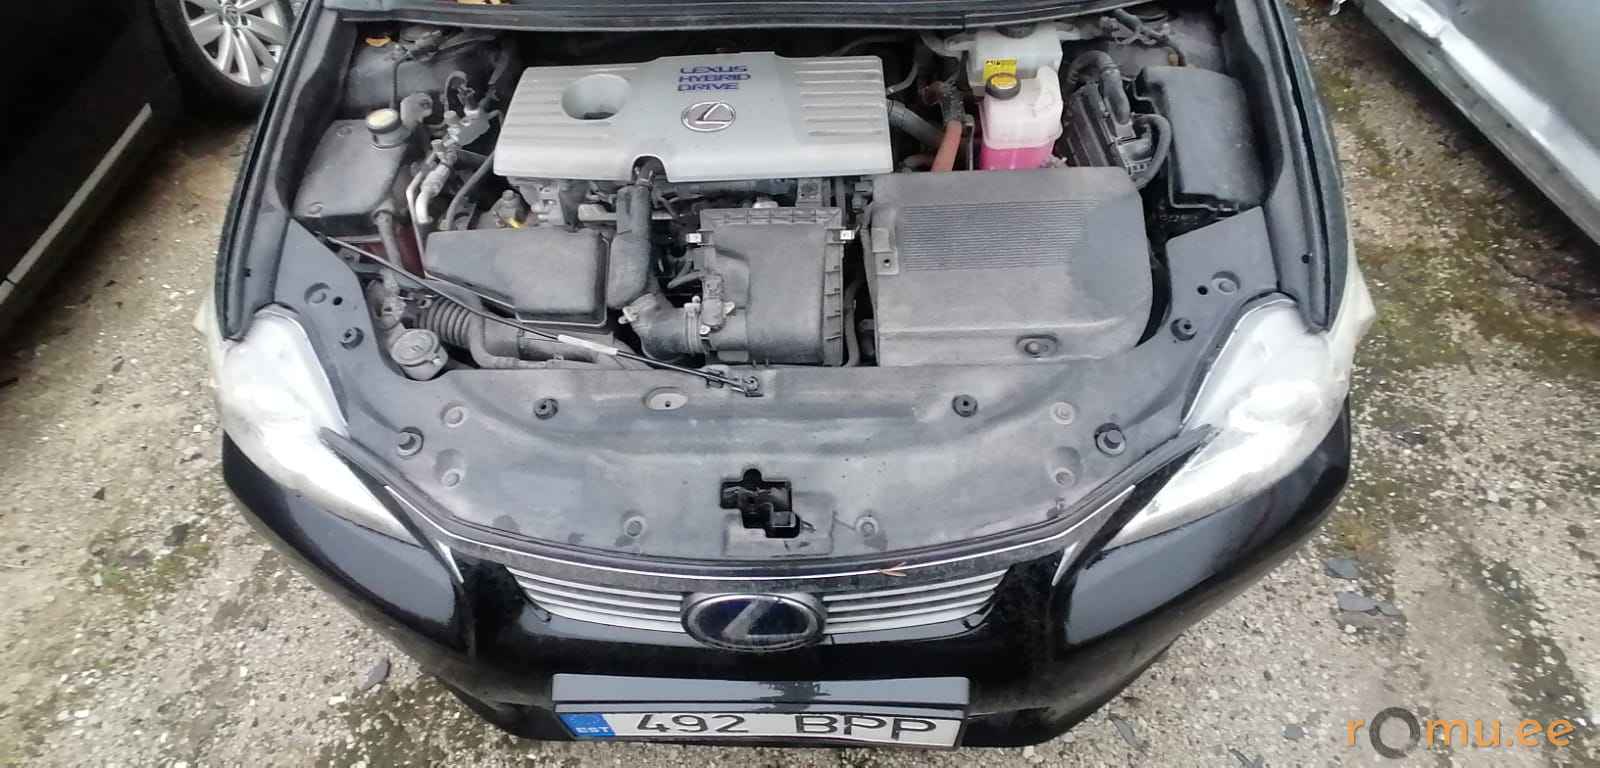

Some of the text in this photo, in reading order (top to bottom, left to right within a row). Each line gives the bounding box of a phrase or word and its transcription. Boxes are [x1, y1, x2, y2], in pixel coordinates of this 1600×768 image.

[680, 65, 748, 74] LEXUS
[679, 73, 751, 82] HYBRID
[678, 82, 739, 91] DRIVE
[576, 726, 609, 734] EST
[637, 714, 937, 741] 492 BPP
